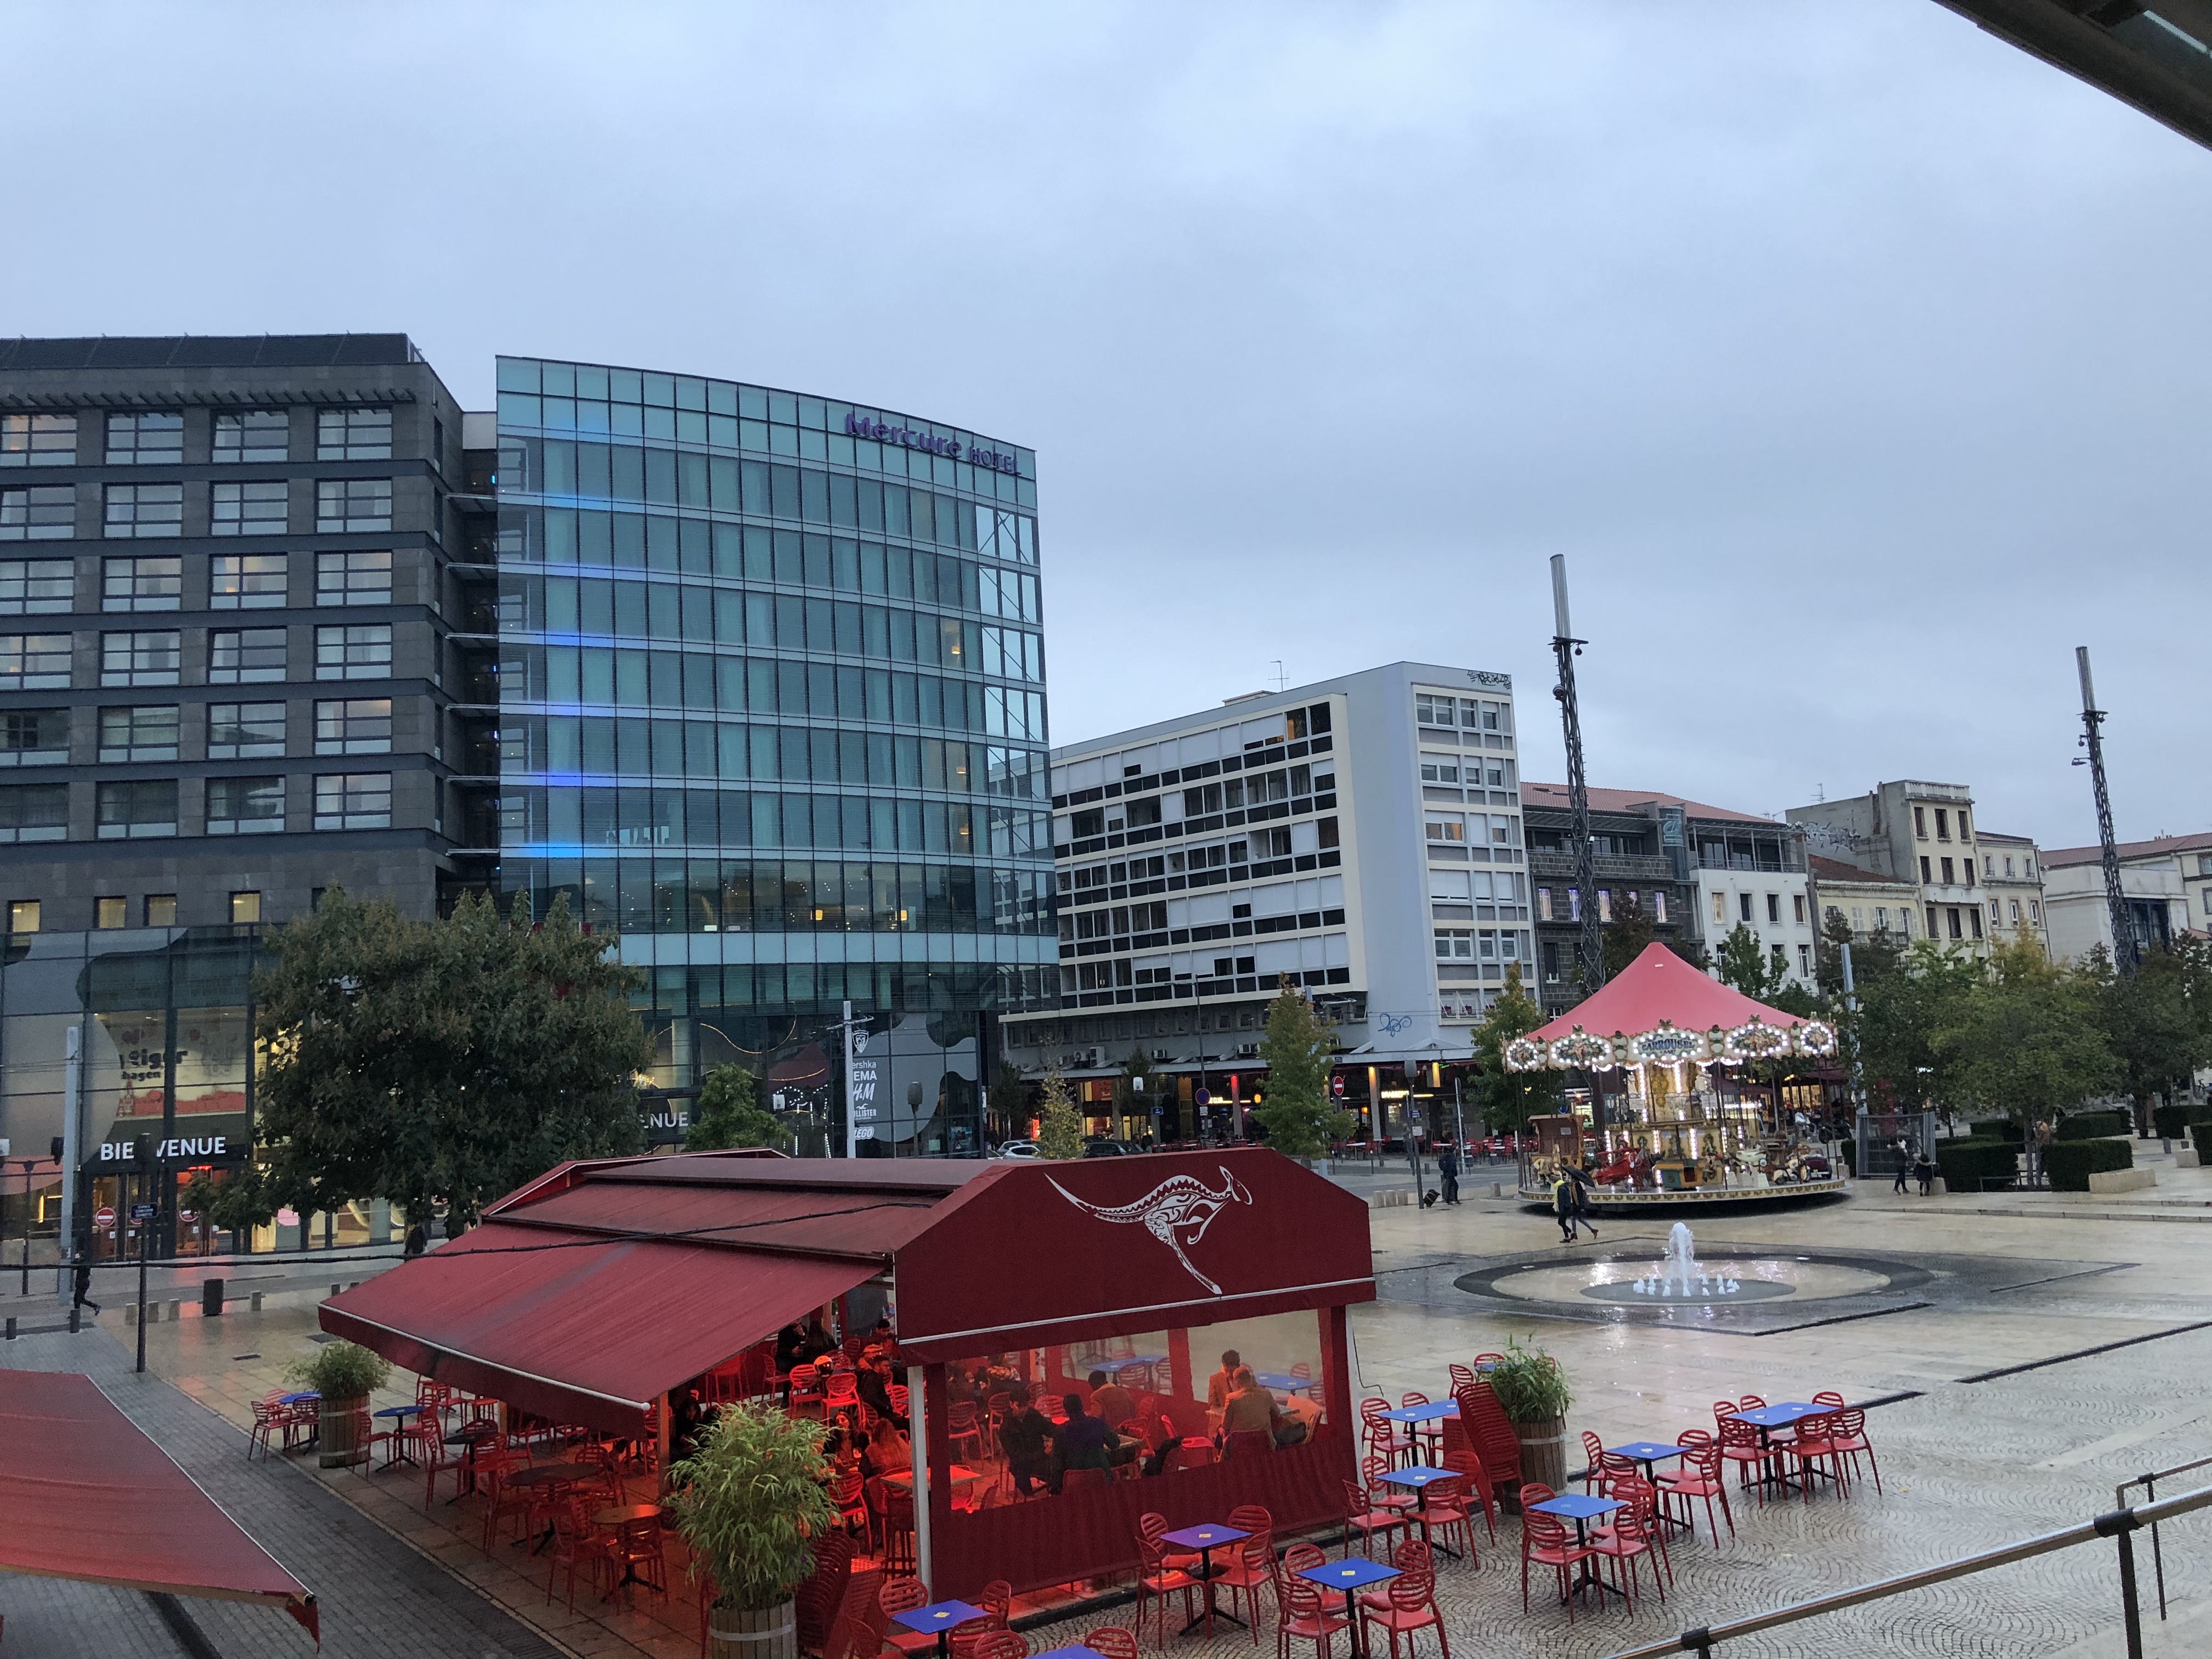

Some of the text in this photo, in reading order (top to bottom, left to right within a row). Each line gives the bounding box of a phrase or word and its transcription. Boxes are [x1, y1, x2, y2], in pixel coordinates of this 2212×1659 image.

[846, 413, 1021, 475] Mercure HOTEL
[1642, 1039, 1695, 1051] CARROUSEL
[854, 1070, 877, 1081] EMA
[853, 1083, 875, 1101] H&M
[101, 1137, 225, 1160] BIEVENUE
